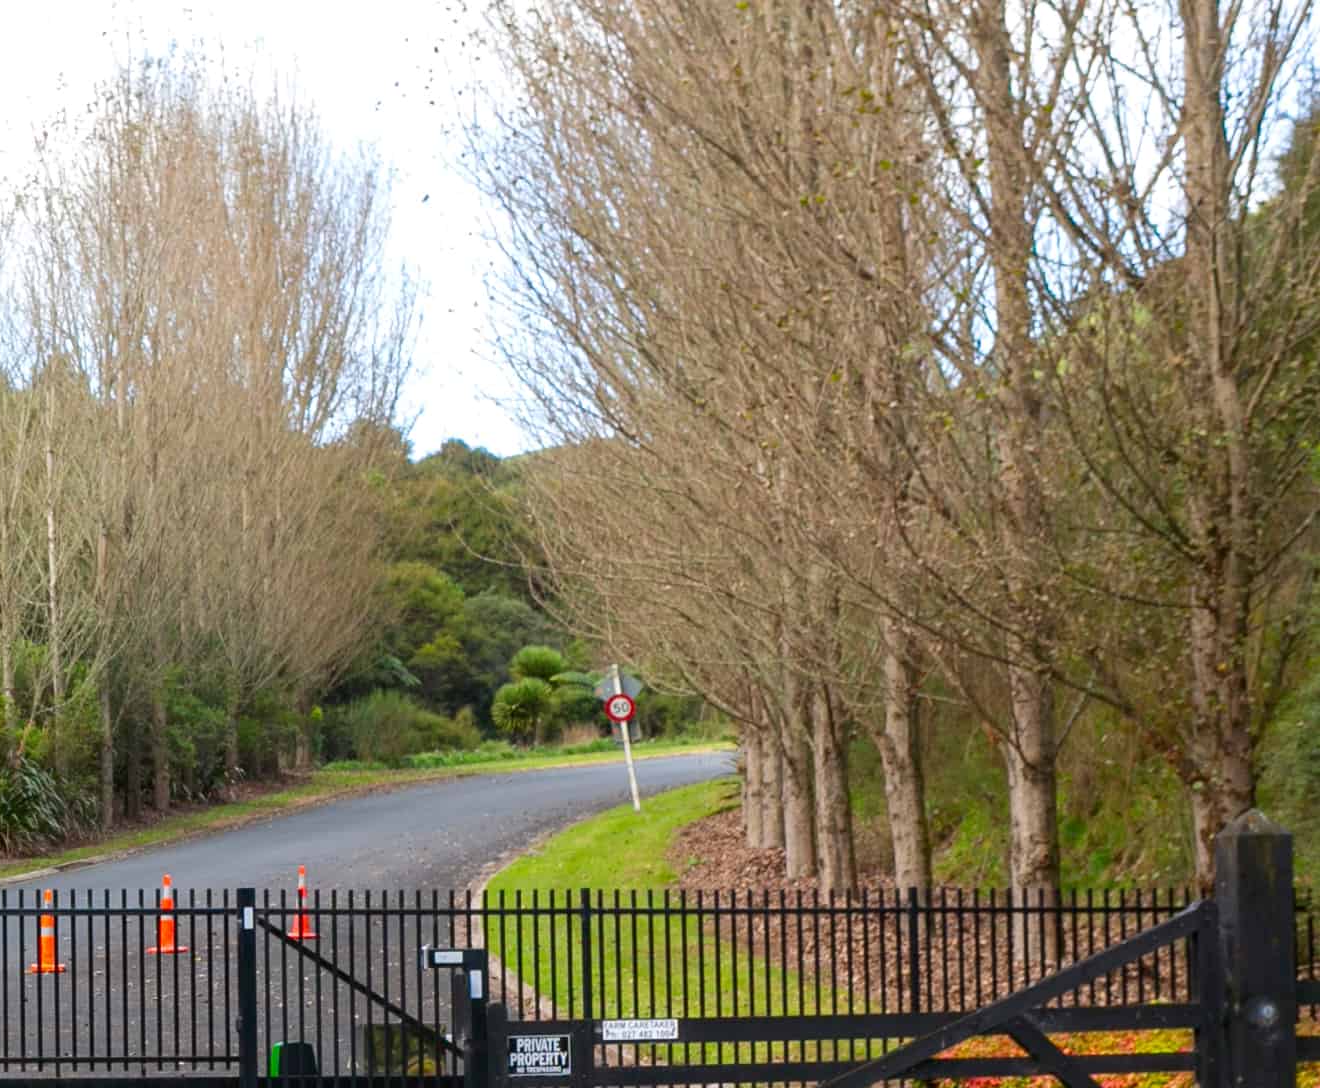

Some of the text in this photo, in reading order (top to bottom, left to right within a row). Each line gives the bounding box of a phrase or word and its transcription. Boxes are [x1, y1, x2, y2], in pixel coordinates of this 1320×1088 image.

[613, 702, 630, 713] 50
[628, 1020, 675, 1028] CARETAKER
[516, 1037, 561, 1052] PRIVATE
[509, 1051, 568, 1067] PROPERTY
